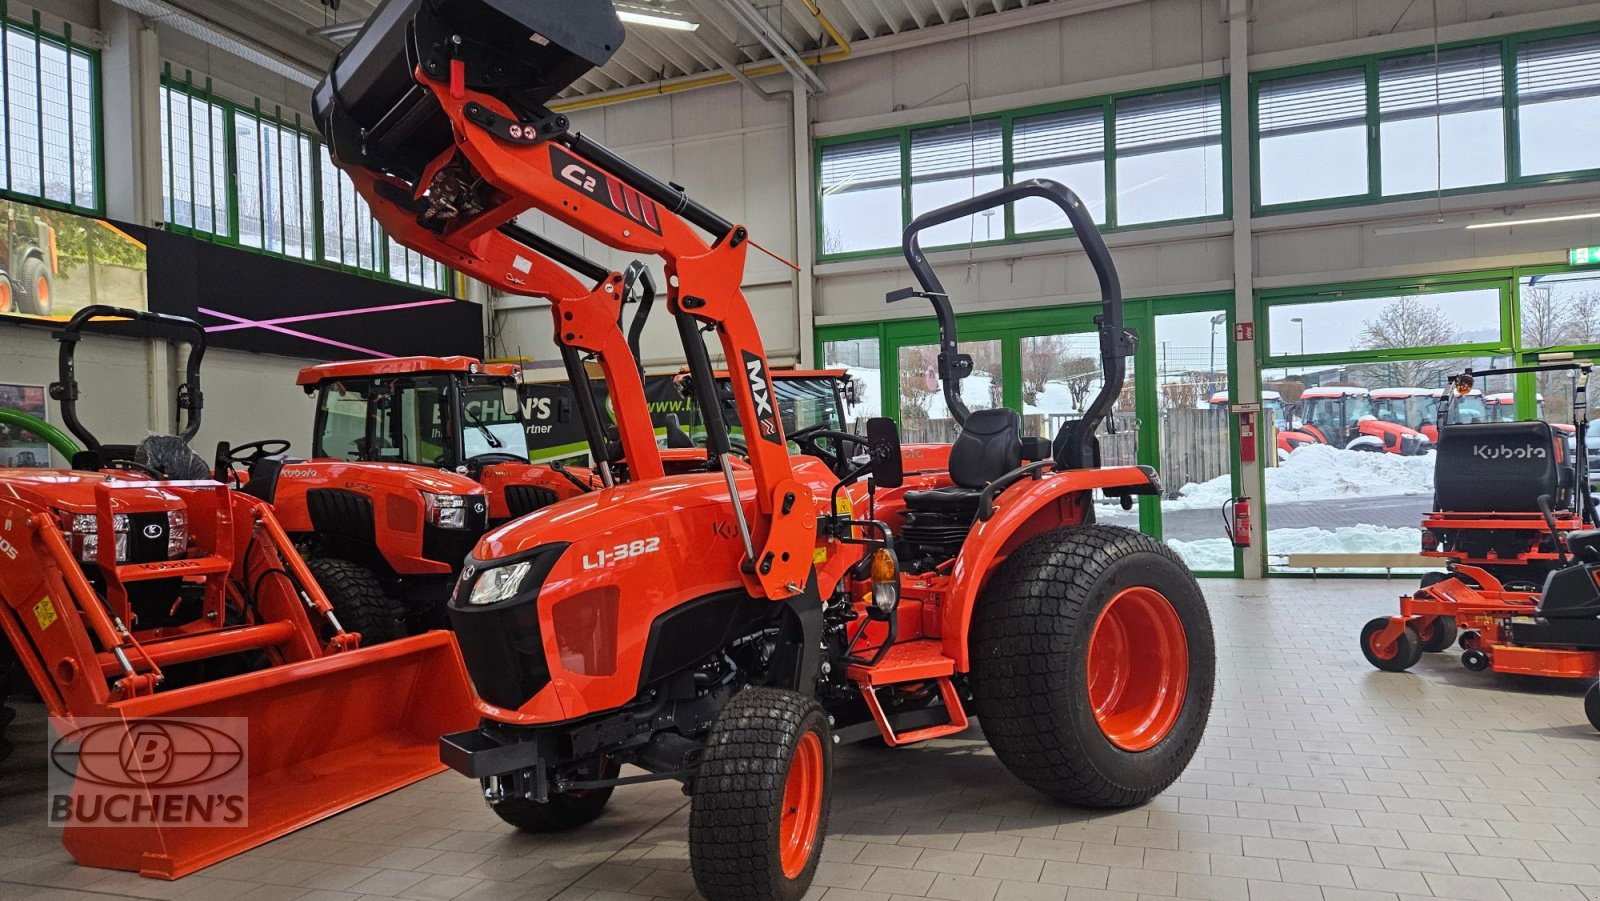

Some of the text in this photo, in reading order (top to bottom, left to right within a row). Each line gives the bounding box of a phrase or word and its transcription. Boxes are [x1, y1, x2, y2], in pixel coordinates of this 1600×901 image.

[560, 164, 596, 193] C2
[746, 359, 772, 417] MX
[432, 397, 551, 424] BCHEN'S
[526, 425, 552, 434] rtner
[1473, 443, 1547, 459] Kubota
[280, 468, 318, 478] Kubota
